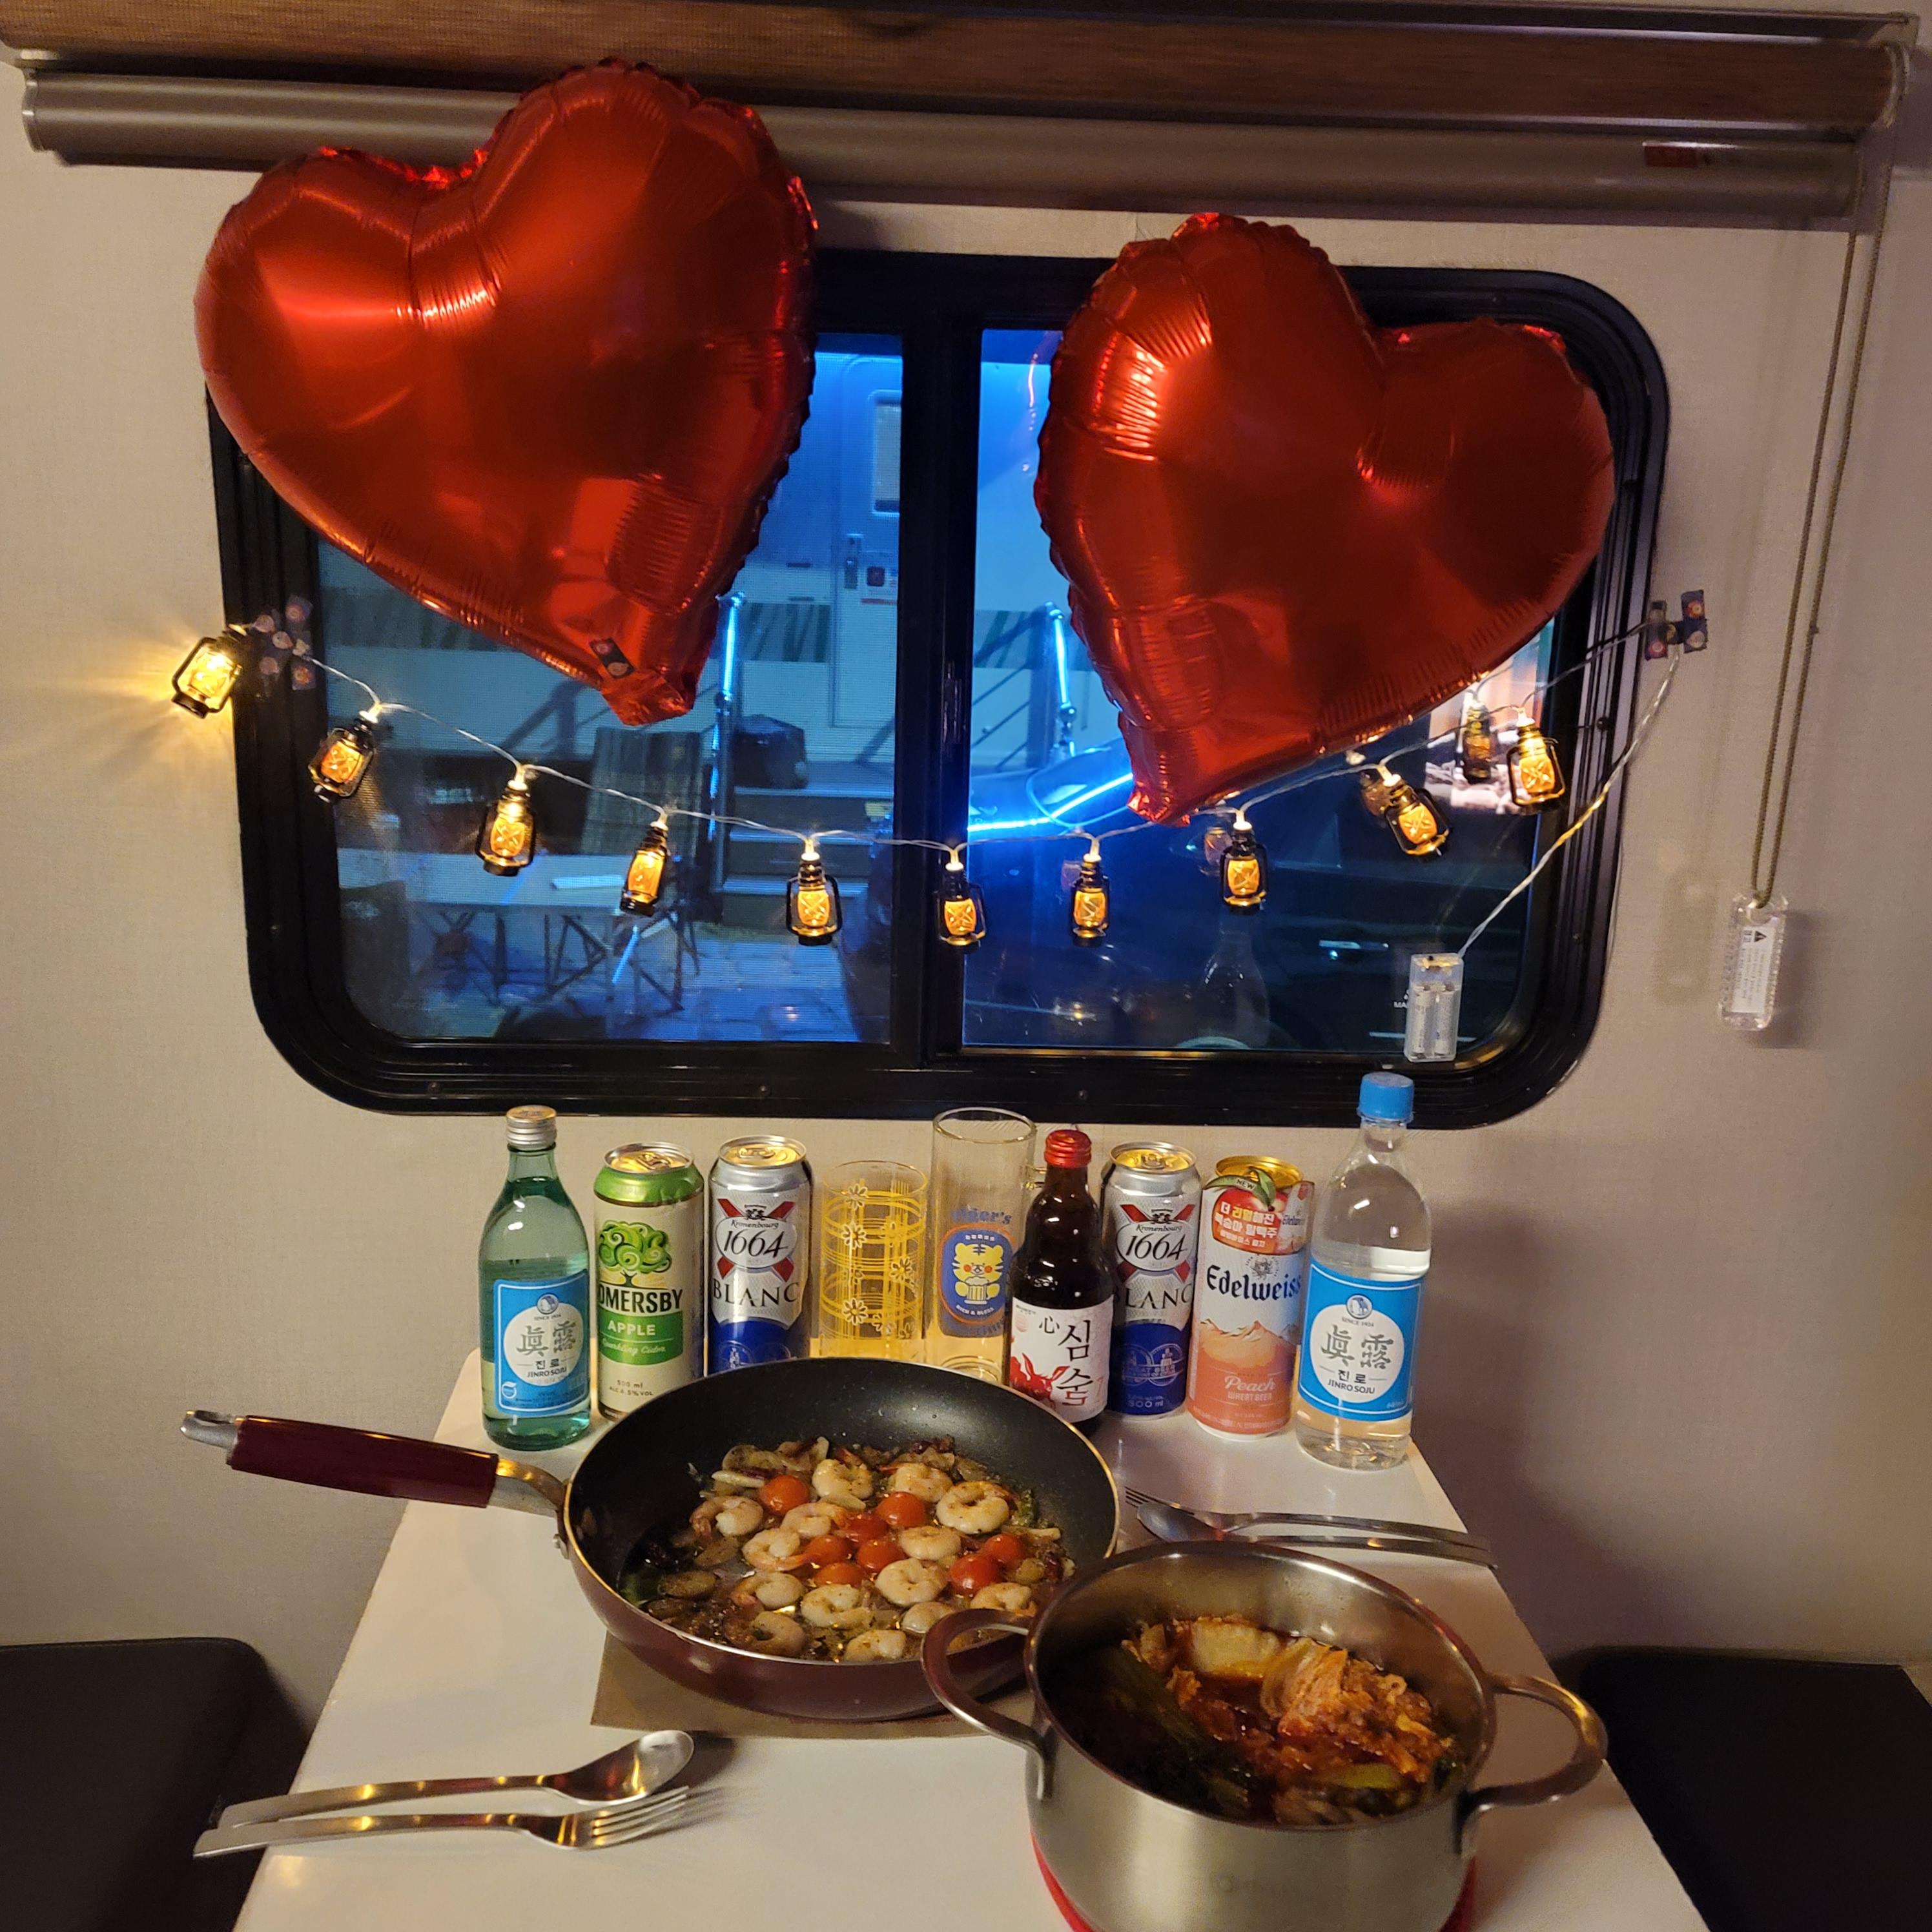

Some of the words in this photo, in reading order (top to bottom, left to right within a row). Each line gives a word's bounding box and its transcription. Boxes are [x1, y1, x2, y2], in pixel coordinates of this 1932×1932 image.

[1237, 1178, 1255, 1190] NEW
[730, 1218, 779, 1229] Kronenbourg
[723, 1229, 789, 1259] 1664
[1125, 1232, 1188, 1260] 1664
[1206, 1264, 1302, 1301] Edelweiss
[599, 1284, 683, 1313] OMERSBY
[712, 1277, 799, 1308] BLANC
[607, 1320, 656, 1336] APPLE
[1038, 1315, 1060, 1334] 心
[535, 1358, 560, 1370] 진로
[527, 1370, 550, 1378] JINRO
[1338, 1369, 1367, 1384] 진로
[1224, 1375, 1277, 1392] Peach
[1328, 1379, 1353, 1392] JINRO
[1353, 1385, 1375, 1394] SOJU
